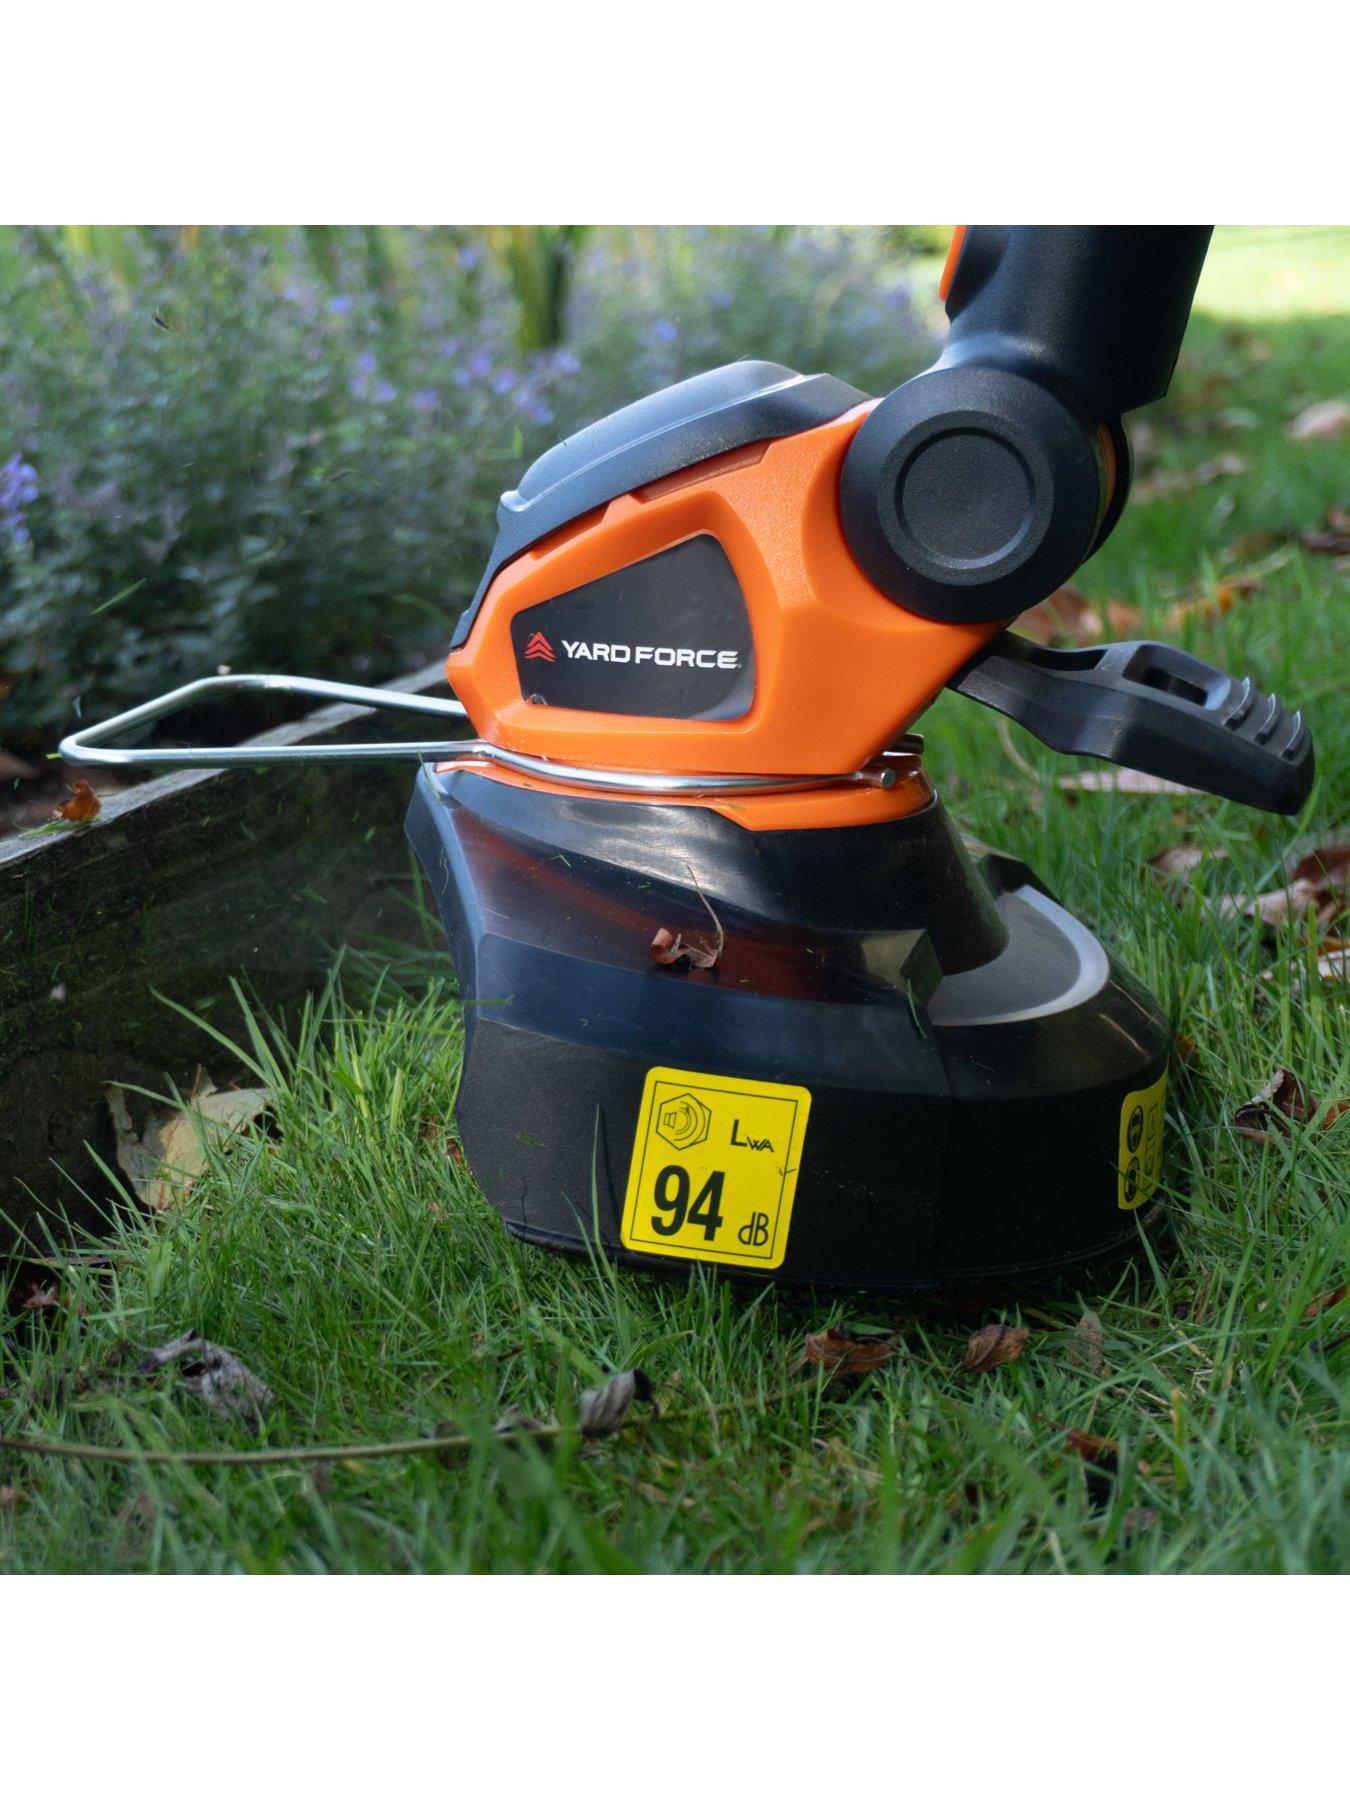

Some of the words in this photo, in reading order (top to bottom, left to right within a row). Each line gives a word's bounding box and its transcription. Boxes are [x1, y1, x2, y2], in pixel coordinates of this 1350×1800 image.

[561, 640, 631, 663] YARD
[635, 646, 739, 669] FORCE
[651, 1164, 726, 1242] 94
[738, 1211, 769, 1247] dB
